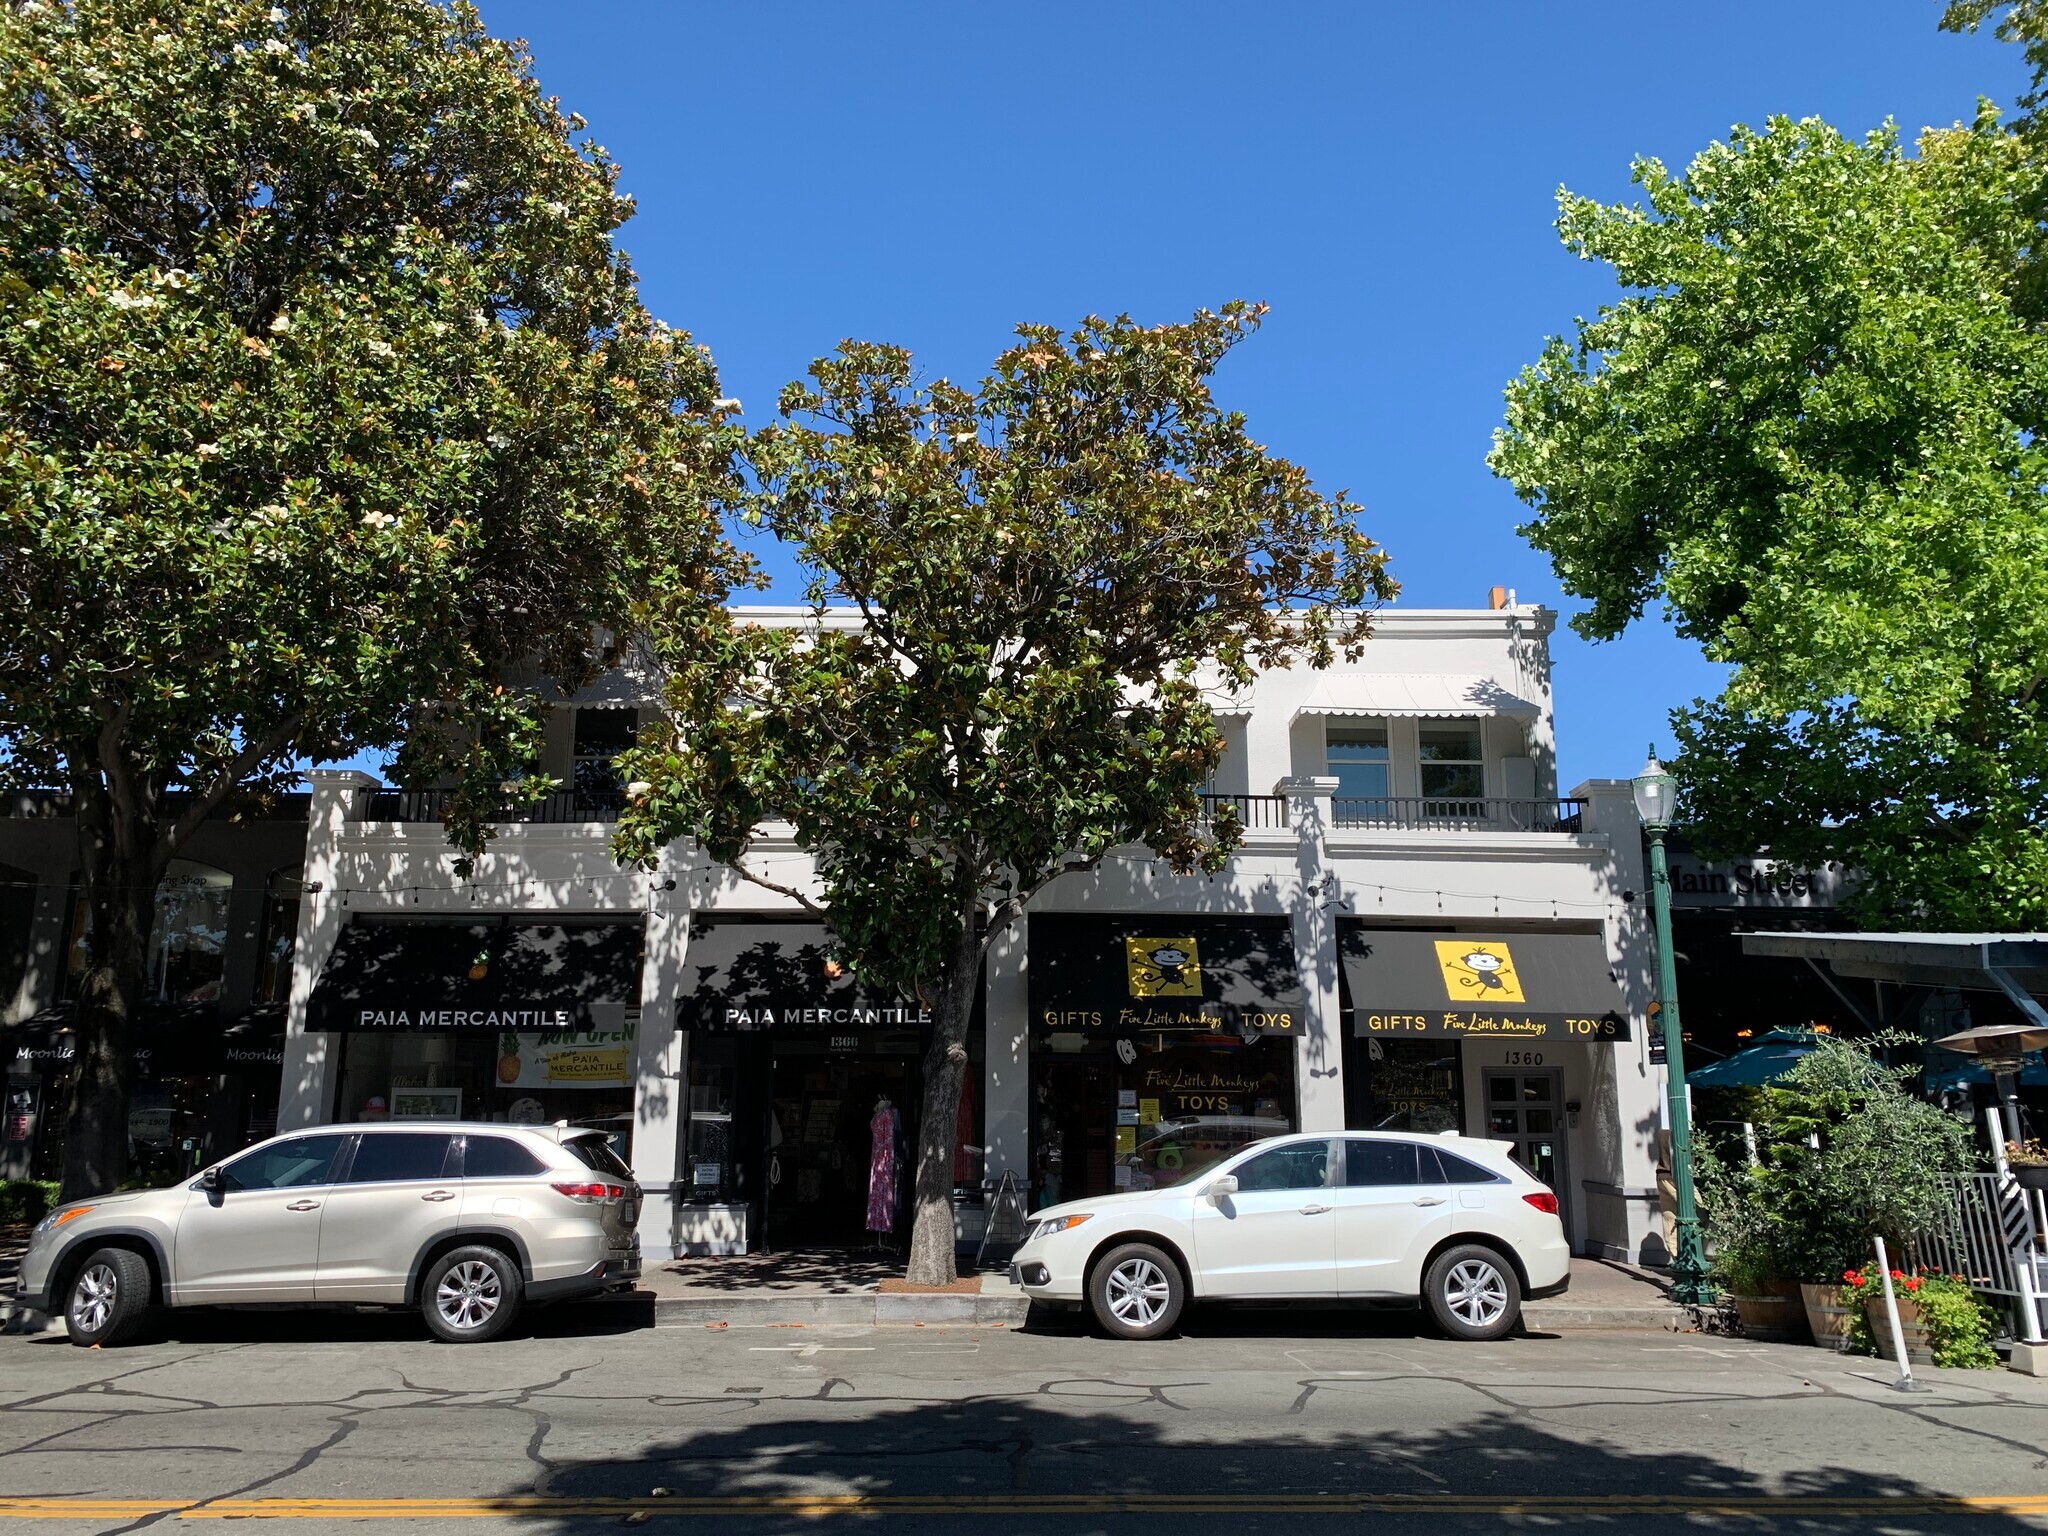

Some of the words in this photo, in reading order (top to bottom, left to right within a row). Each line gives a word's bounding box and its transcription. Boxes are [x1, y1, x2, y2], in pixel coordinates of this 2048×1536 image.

[181, 874, 207, 887] Shop
[360, 1010, 411, 1026] PAIA
[419, 1010, 569, 1026] MERCANTILE
[725, 1008, 776, 1024] PAIA
[784, 1008, 932, 1024] MERCANTILE
[1045, 1011, 1102, 1026] GIFTS
[1119, 1007, 1143, 1025] Five
[1144, 1008, 1175, 1026] Little
[1177, 1011, 1222, 1029] Monkeys
[1240, 1013, 1292, 1028] TOYS
[1368, 1014, 1427, 1031] GIFTS
[1443, 1011, 1467, 1031] Five
[1468, 1012, 1500, 1031] Little
[1501, 1018, 1547, 1036] Monkeys
[1564, 1019, 1616, 1035] TOYS
[830, 1036, 859, 1047] 1366
[1505, 1050, 1543, 1066] 1360
[551, 1063, 624, 1073] MERCANTILE
[1146, 1069, 1171, 1087] Five
[1173, 1068, 1206, 1088] Little
[1210, 1074, 1260, 1094] Monkeys
[1177, 1095, 1229, 1110] TOYS
[1390, 1101, 1427, 1112] TOYS
